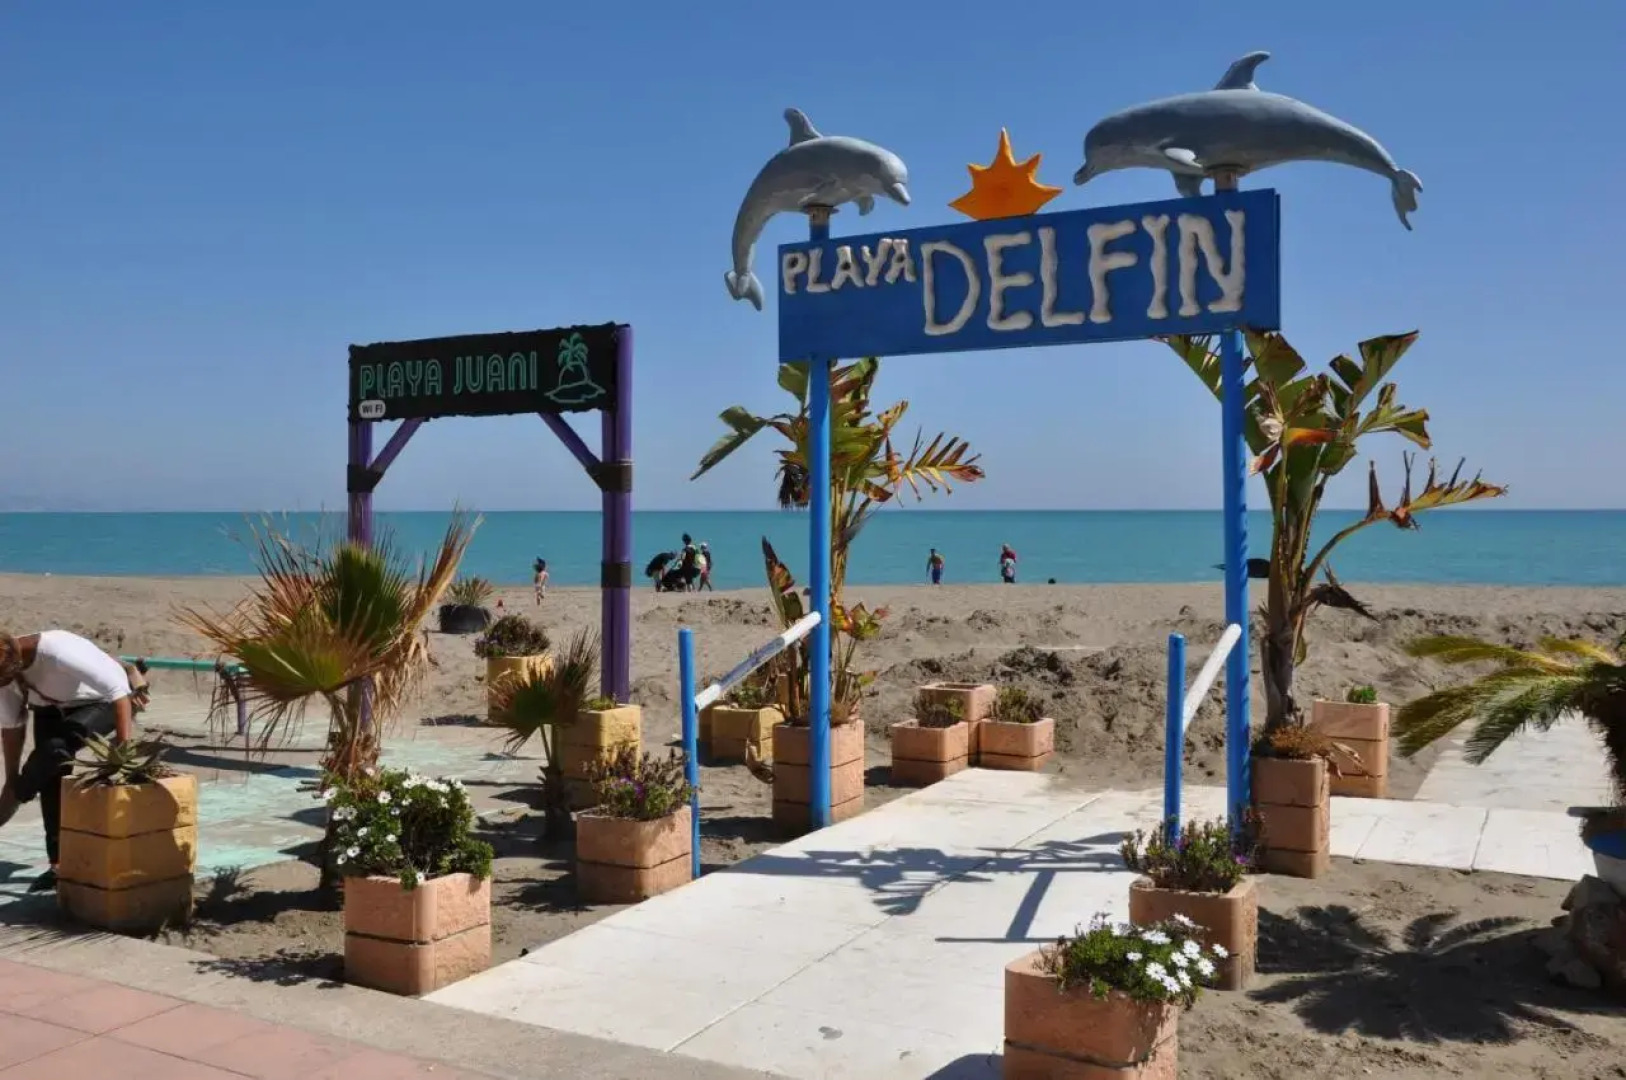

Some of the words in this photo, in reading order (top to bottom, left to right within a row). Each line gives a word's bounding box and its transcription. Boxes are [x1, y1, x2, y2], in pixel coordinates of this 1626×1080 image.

[782, 238, 916, 294] PLAYA
[920, 209, 1245, 336] DELFIN
[360, 359, 442, 399] PLAYA
[453, 351, 538, 395] JUANI
